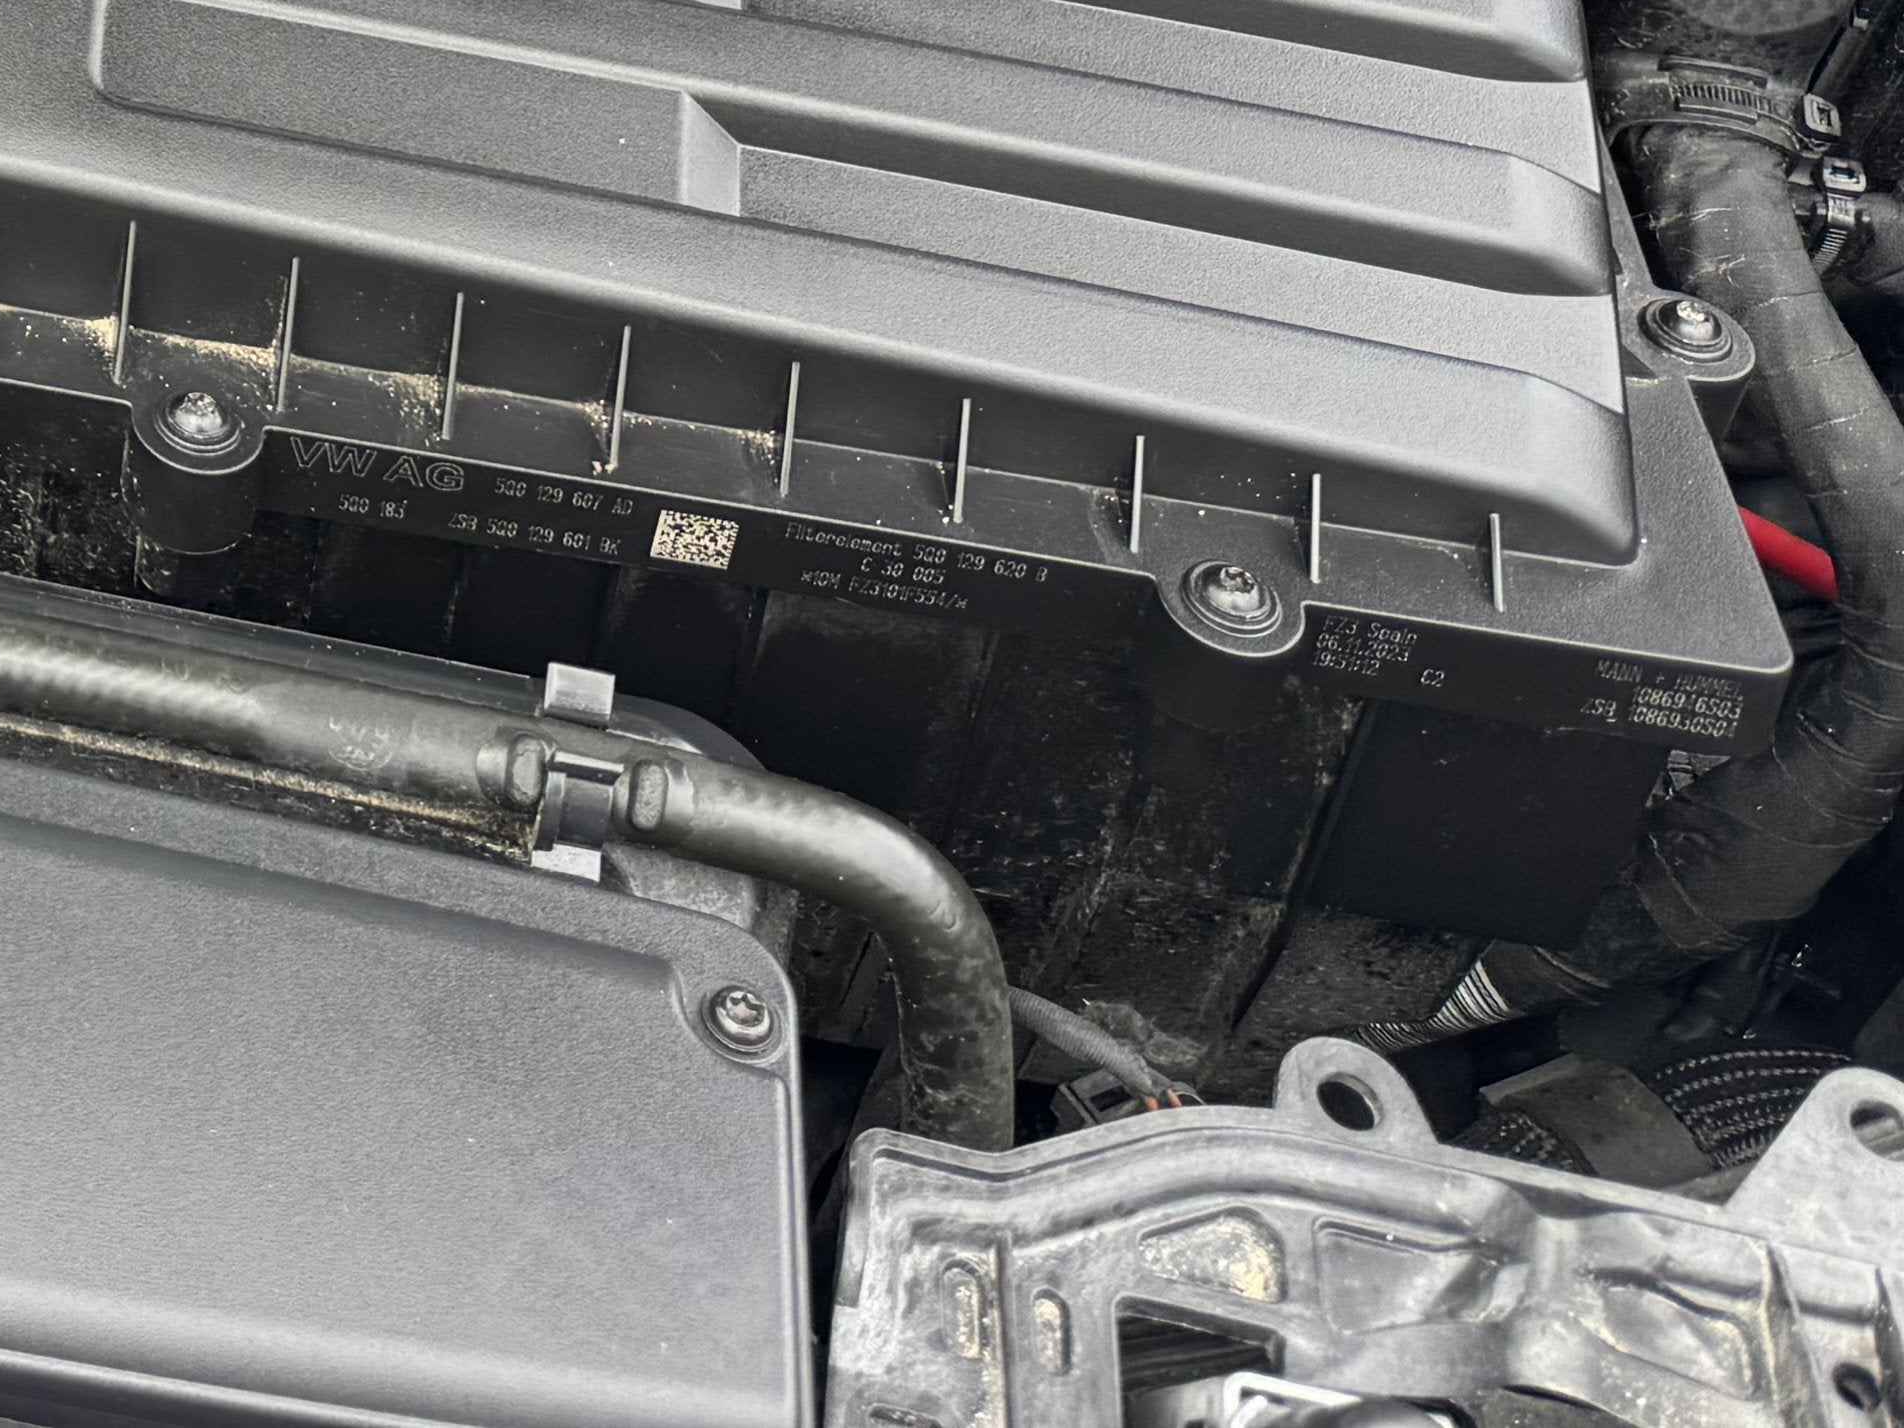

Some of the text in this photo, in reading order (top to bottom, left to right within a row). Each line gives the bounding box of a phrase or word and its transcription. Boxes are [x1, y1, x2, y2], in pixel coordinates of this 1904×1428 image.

[290, 436, 378, 477] VW
[383, 455, 465, 492] AG
[537, 485, 564, 504] 129
[572, 491, 603, 510] 607
[528, 525, 554, 544] 129
[562, 531, 590, 550] 601
[861, 557, 873, 573] C
[881, 560, 904, 577] 30
[956, 551, 986, 571] 129
[993, 559, 1028, 579] 620
[1316, 633, 1410, 662] 06.11.2023
[1420, 669, 1446, 688] C2
[1595, 659, 1643, 684] MANN
[1674, 672, 1744, 700] HUMMEL
